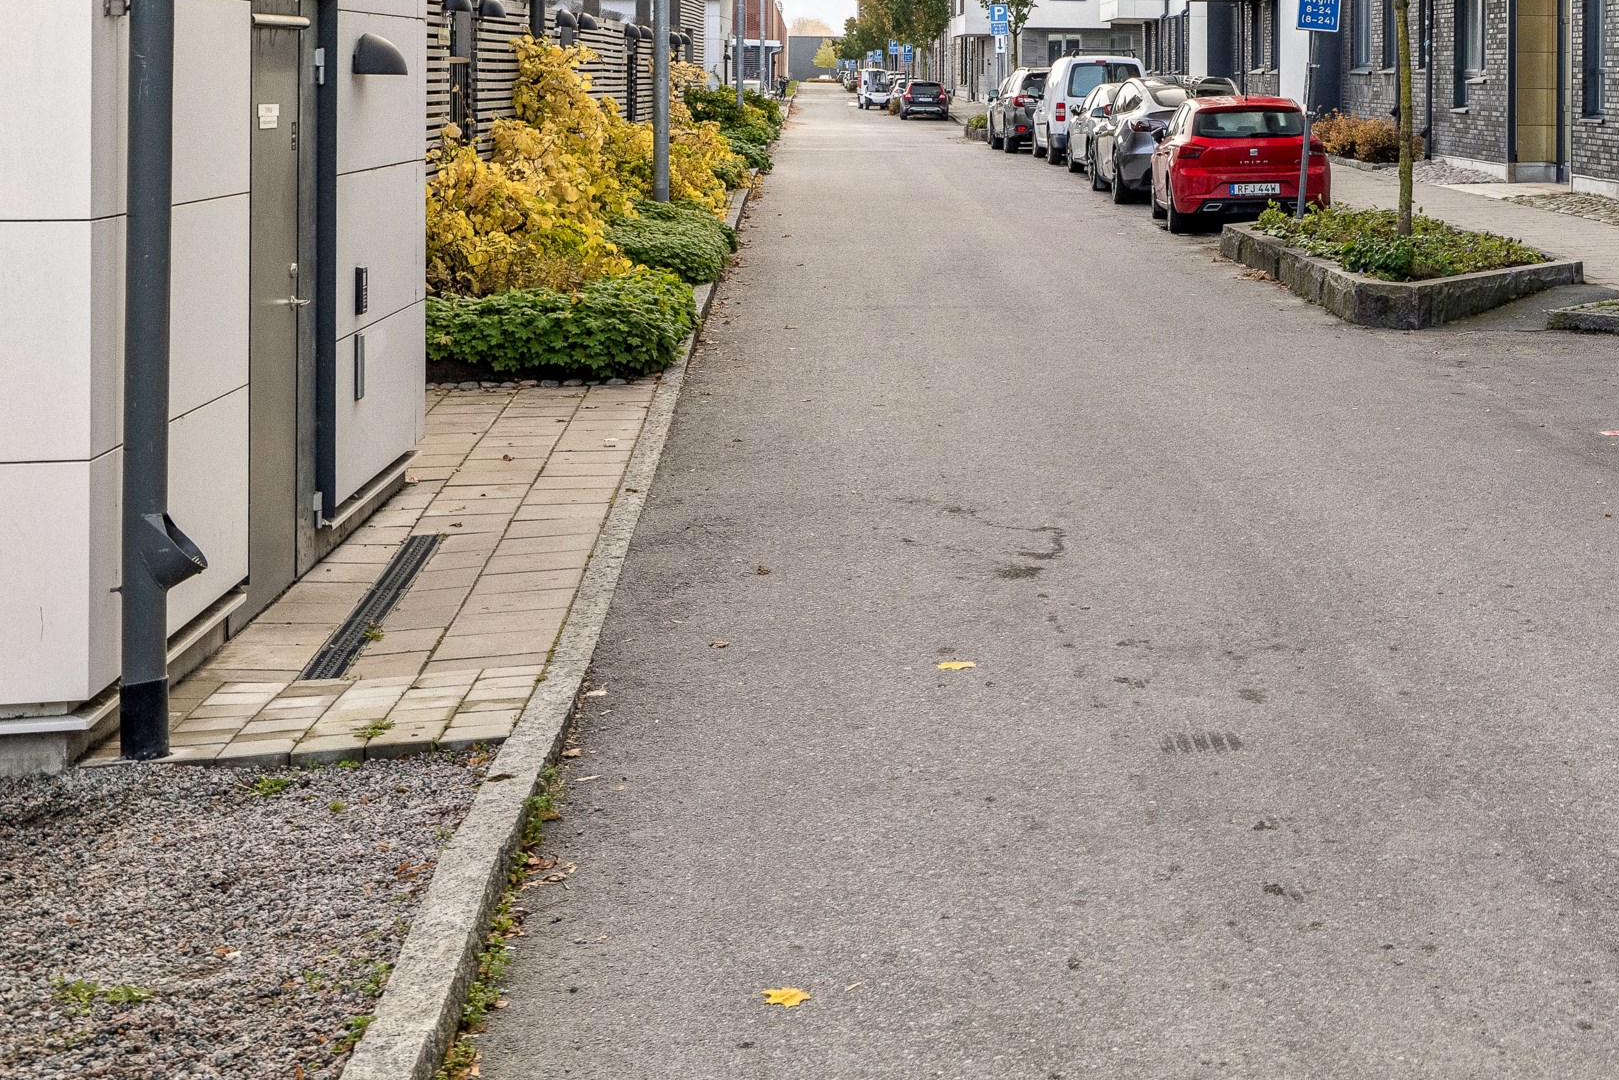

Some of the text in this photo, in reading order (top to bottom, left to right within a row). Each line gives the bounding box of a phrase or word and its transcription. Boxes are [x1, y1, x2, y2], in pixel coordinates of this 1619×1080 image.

[994, 6, 1005, 21] P
[1306, 5, 1331, 14] 8-24
[1301, 15, 1335, 25] (8-24)
[905, 44, 911, 53] P
[1237, 184, 1276, 193] RFJ 44W
